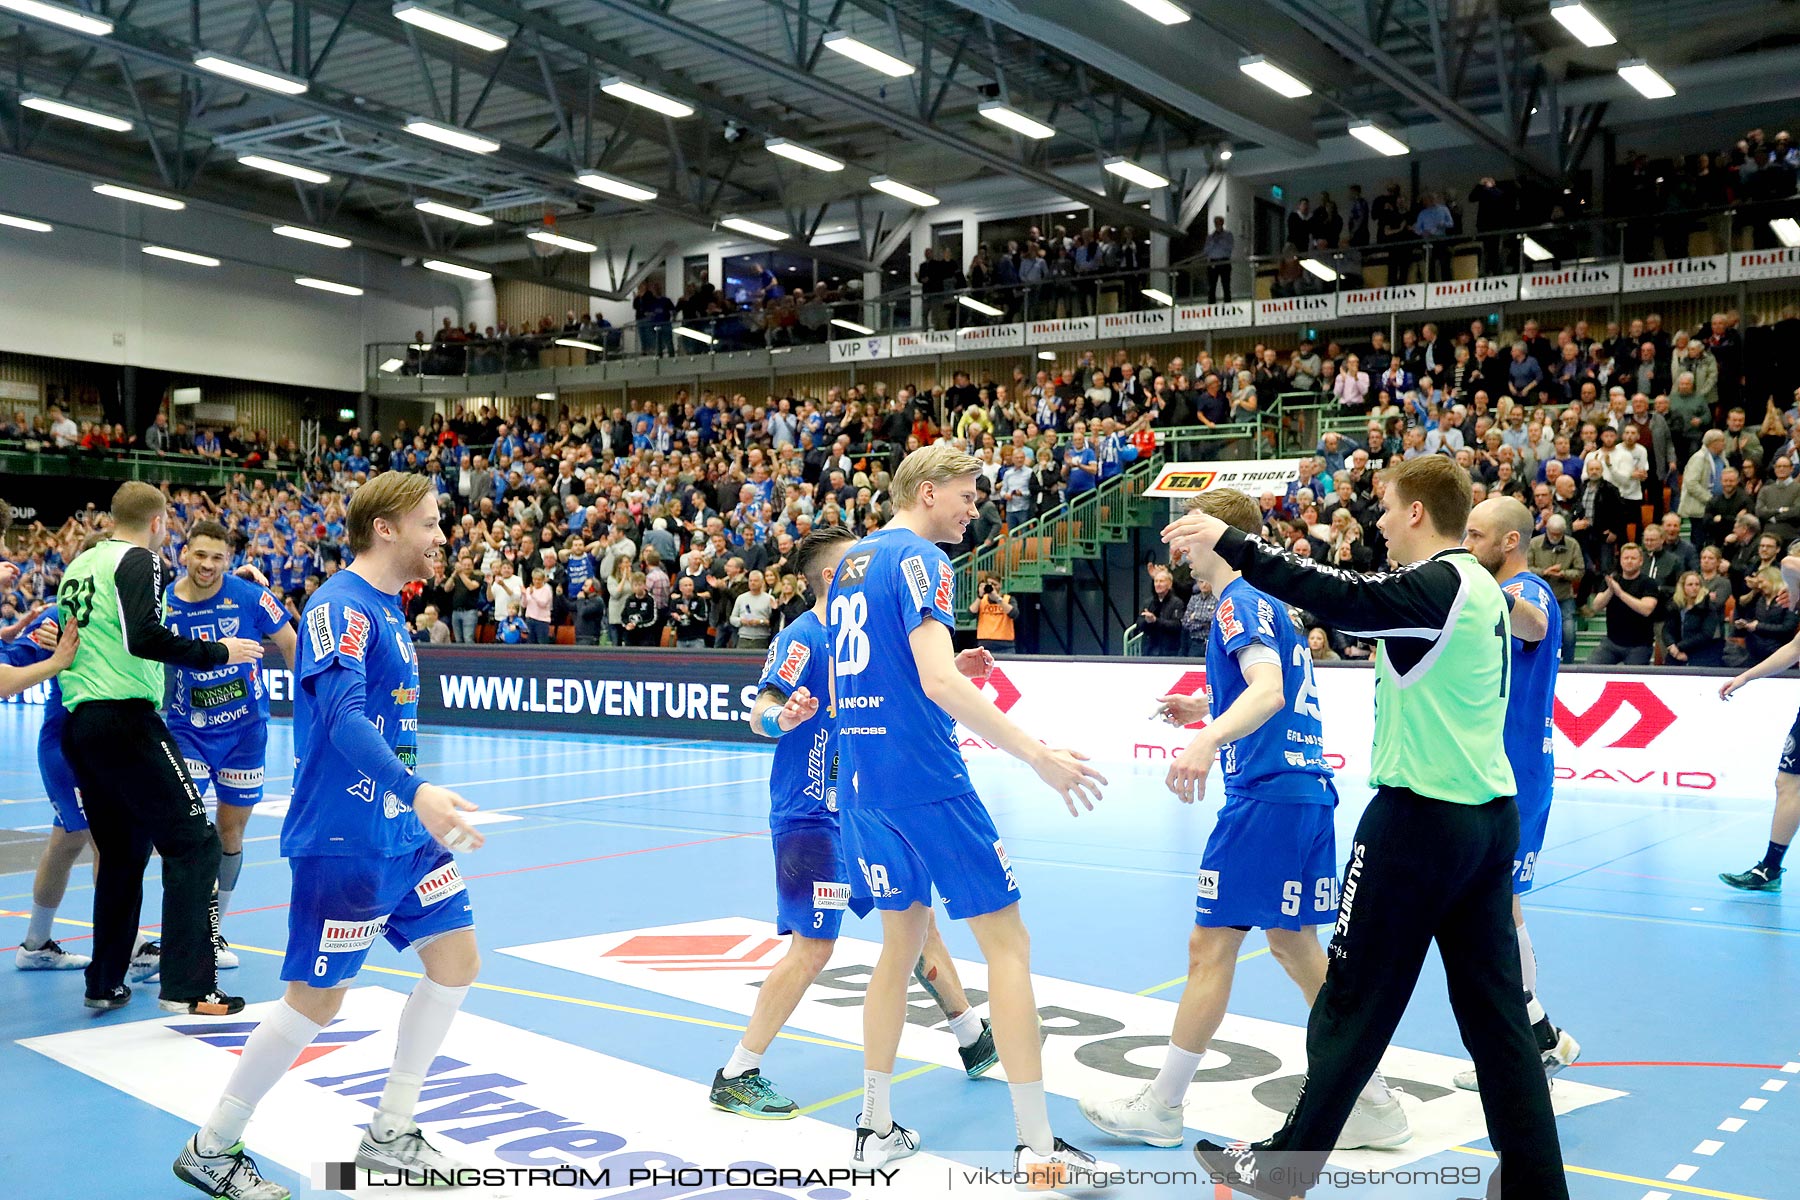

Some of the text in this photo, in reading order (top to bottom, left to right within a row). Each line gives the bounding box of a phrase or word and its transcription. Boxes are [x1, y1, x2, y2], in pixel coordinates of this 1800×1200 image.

[1531, 268, 1609, 286] mattias
[1633, 258, 1716, 278] mattias
[1347, 286, 1416, 304] mattias
[1435, 277, 1509, 296] mattias
[1181, 303, 1244, 320] mattias
[1262, 297, 1328, 313] mattias
[1033, 318, 1089, 334] mattias
[1105, 310, 1164, 327] mattias
[838, 342, 861, 358] VIP
[1238, 471, 1285, 481] TRUCK
[936, 563, 951, 612] MAXI
[1219, 599, 1238, 639] MAXI
[340, 610, 366, 657] MAXI
[830, 591, 870, 678] 28
[396, 632, 409, 663] 6
[779, 643, 807, 683] MAXI
[203, 692, 235, 707] HUSET
[208, 704, 249, 725] SKÖVDE
[160, 741, 196, 801] PRO TRAINING
[1334, 841, 1366, 937] SALMING
[813, 911, 824, 929] 3
[314, 955, 328, 977] 6
[865, 1077, 876, 1127] SALMING
